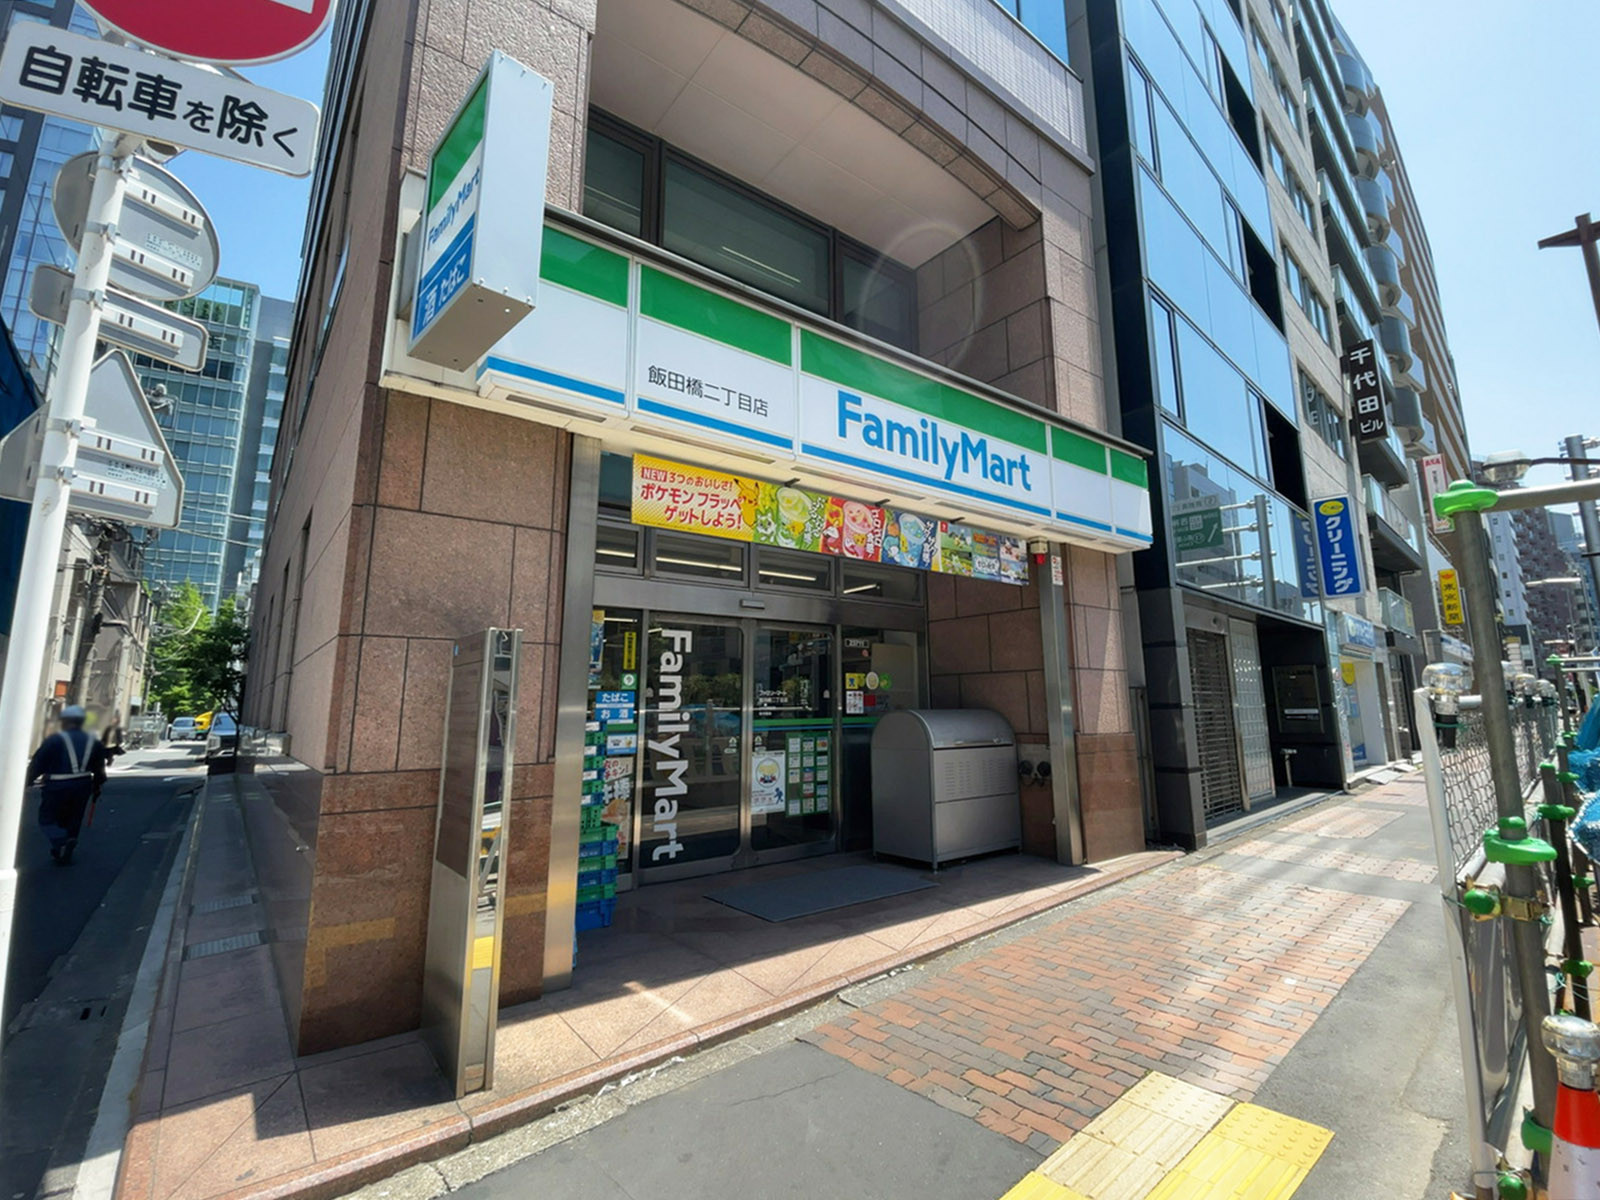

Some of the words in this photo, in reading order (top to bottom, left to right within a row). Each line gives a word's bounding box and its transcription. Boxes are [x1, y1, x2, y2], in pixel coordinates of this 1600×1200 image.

[18, 45, 299, 158] 自転車を除く
[426, 166, 481, 252] FamilyMart
[422, 285, 438, 326] 酒
[438, 253, 468, 306] たばこ
[648, 364, 769, 418] 飯田橋二丁目店
[1350, 347, 1384, 434] 千代田ビル
[642, 467, 667, 482] NEW
[836, 389, 1033, 492] FamilyMart
[664, 506, 743, 530] ゲットしよう!
[1325, 516, 1353, 594] クリーニング
[601, 692, 629, 703] たばこ
[648, 629, 693, 862] FamilyMart
